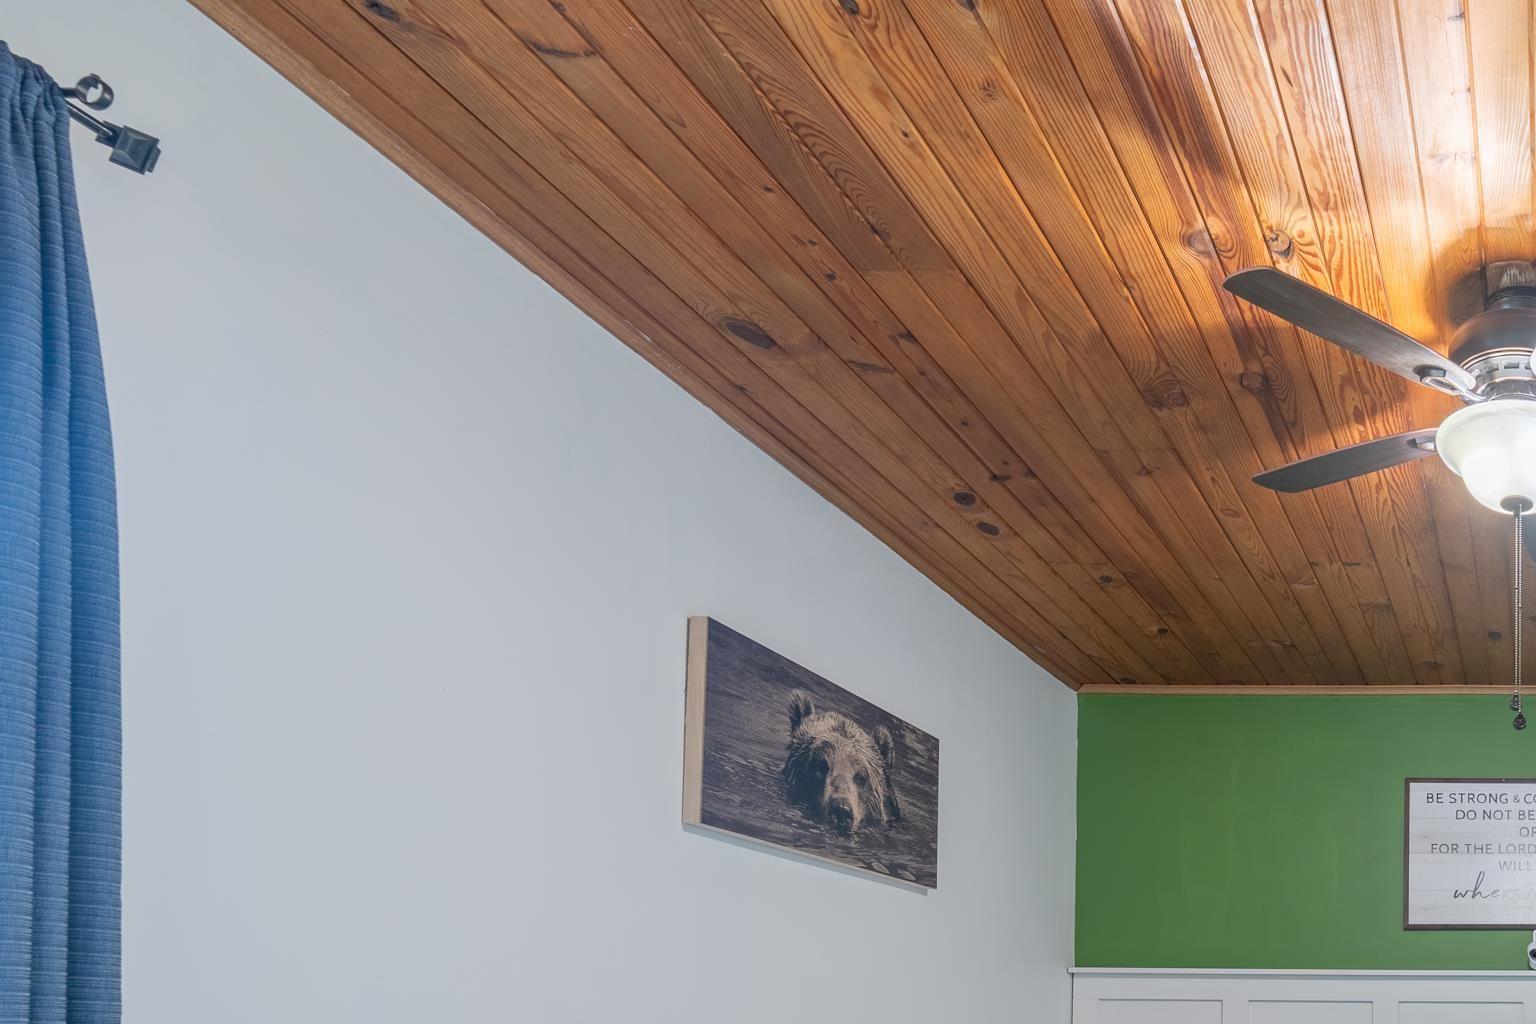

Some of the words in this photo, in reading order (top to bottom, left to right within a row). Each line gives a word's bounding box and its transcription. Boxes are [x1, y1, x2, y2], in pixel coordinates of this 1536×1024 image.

[1426, 793, 1444, 804] BE
[1448, 793, 1508, 804] STRONG
[1513, 794, 1520, 803] &
[1455, 809, 1477, 820] DO
[1483, 809, 1512, 820] NOT
[1518, 809, 1535, 820] BE
[1431, 843, 1459, 854] FOR
[1464, 843, 1492, 854] THE
[1498, 843, 1536, 854] LORD
[1498, 860, 1532, 871] WILL
